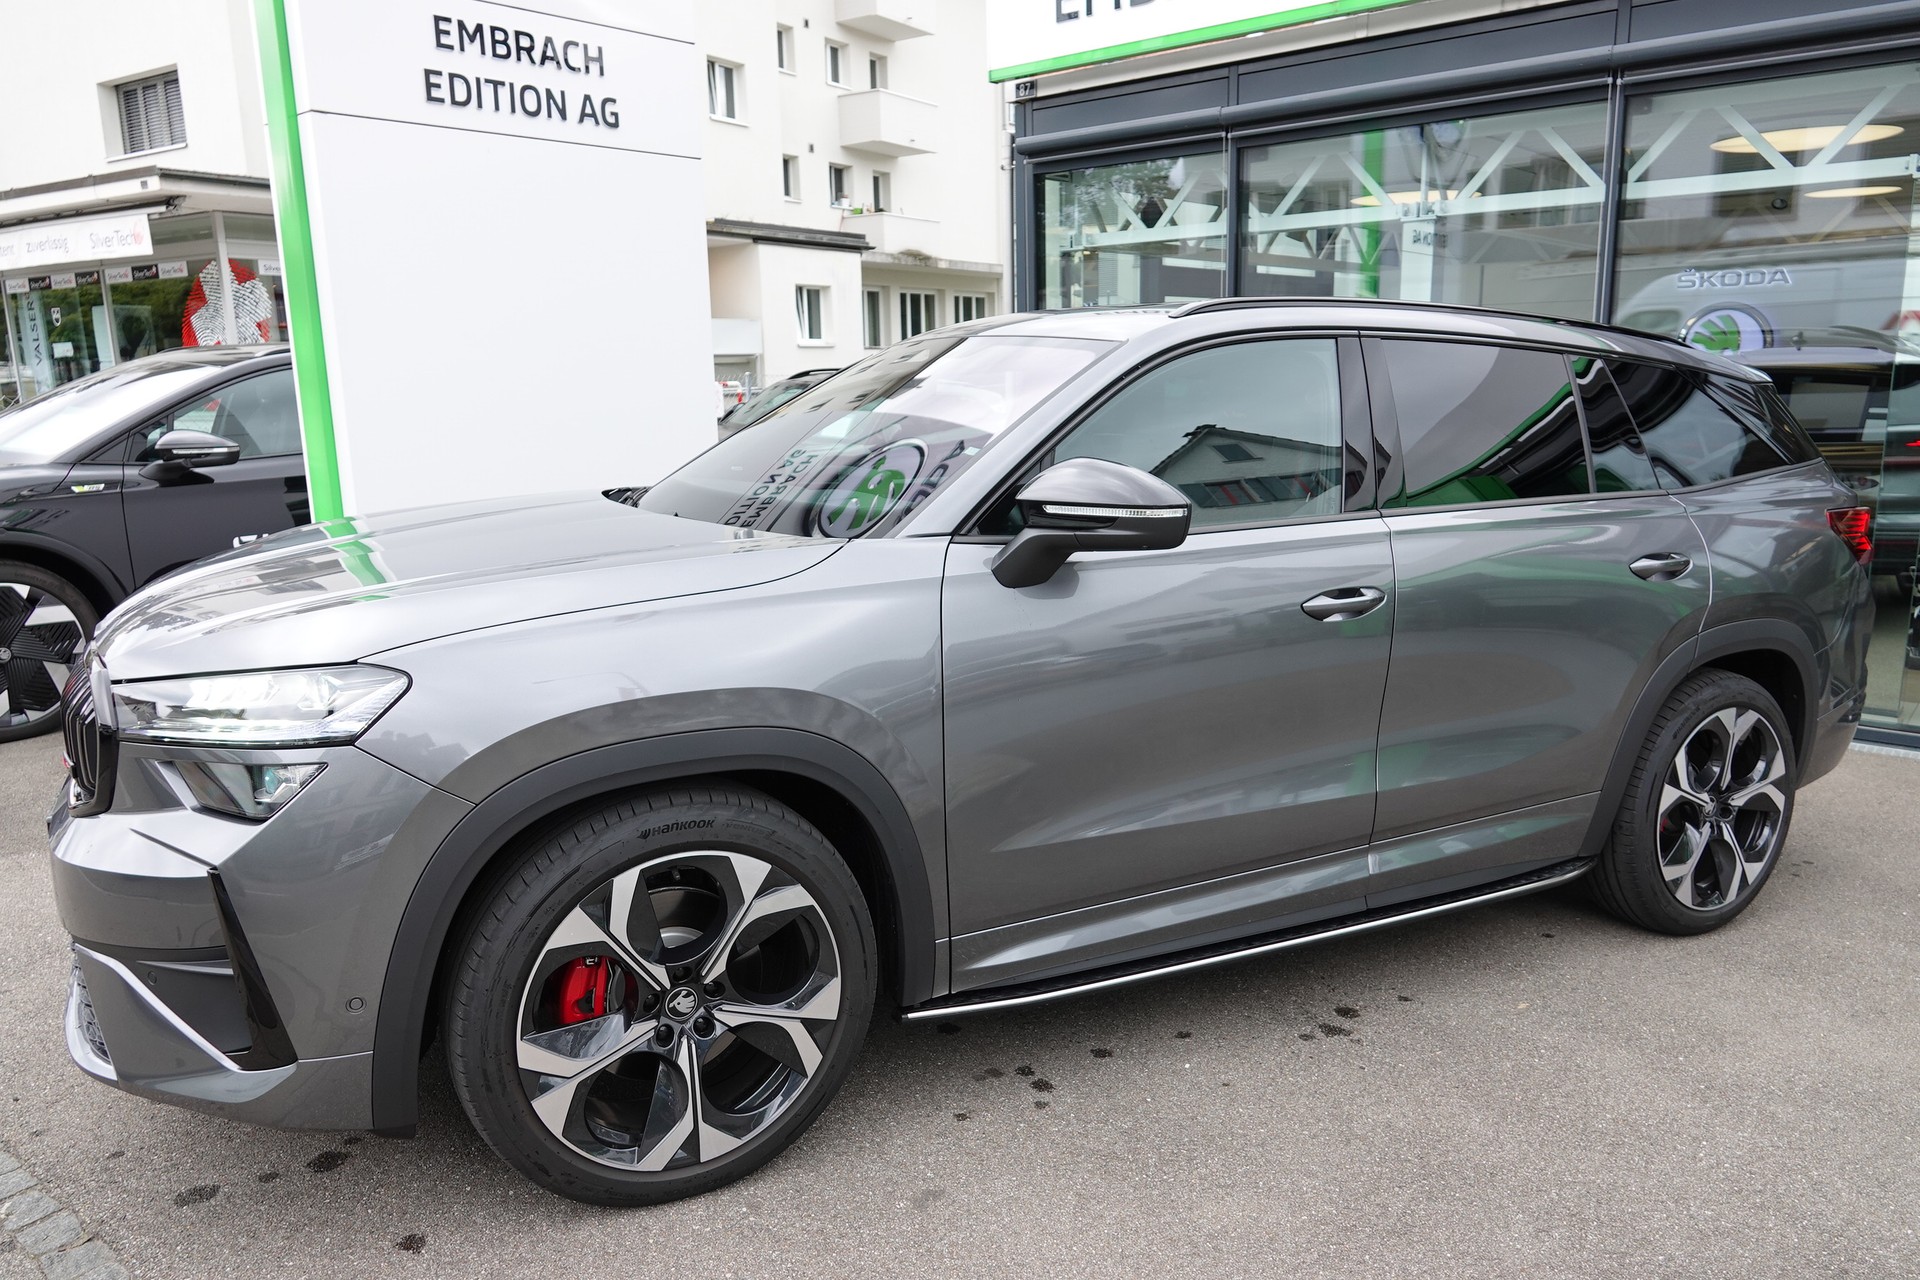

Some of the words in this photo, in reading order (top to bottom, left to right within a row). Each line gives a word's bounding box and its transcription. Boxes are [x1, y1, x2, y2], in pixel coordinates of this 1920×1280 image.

[433, 14, 605, 77] EMBRACH
[424, 68, 567, 121] EDITION
[578, 94, 620, 129] AG
[1018, 82, 1031, 96] 87
[1677, 268, 1792, 289] ŠKODA
